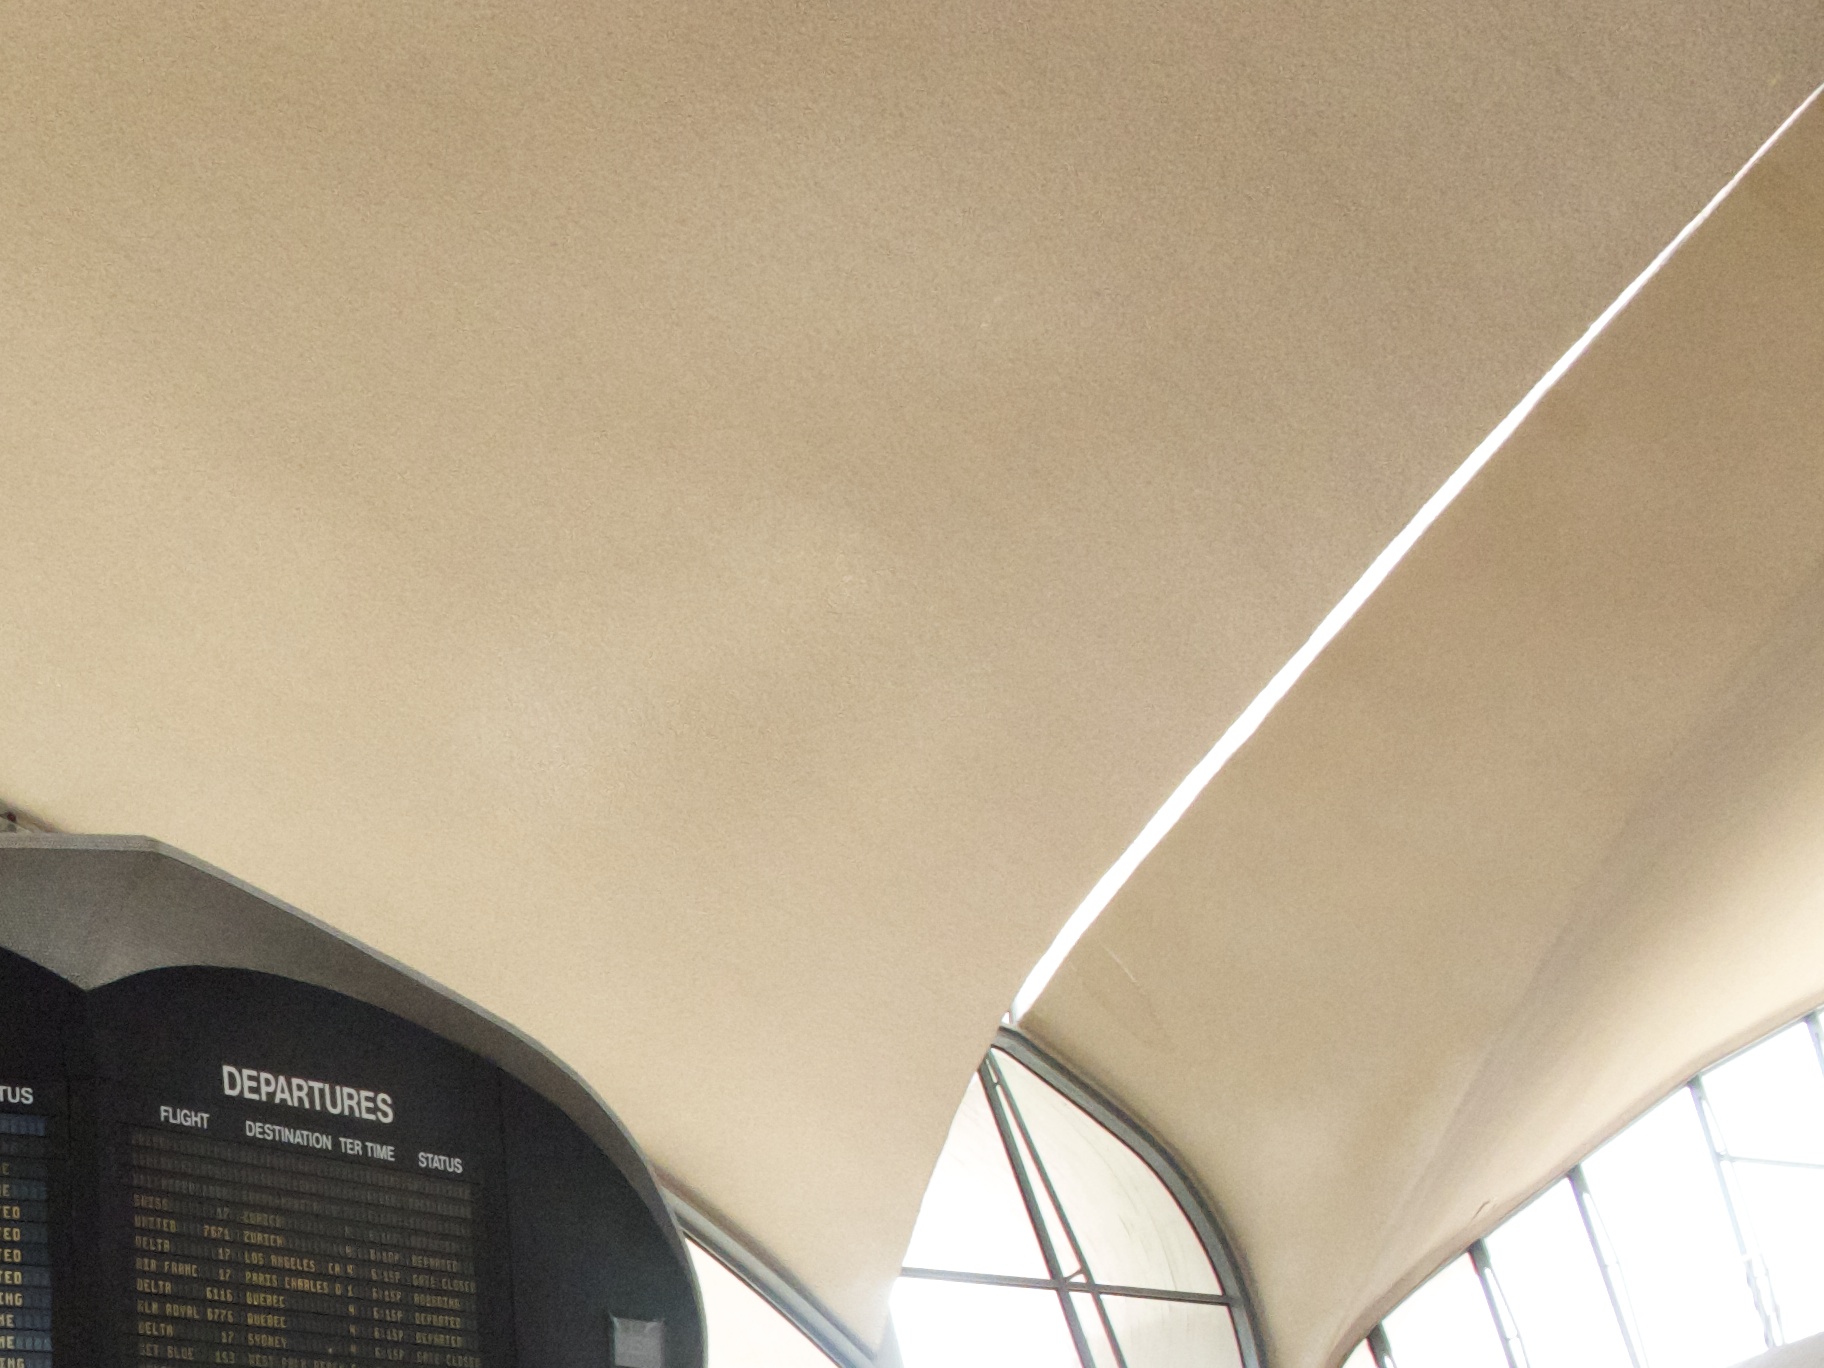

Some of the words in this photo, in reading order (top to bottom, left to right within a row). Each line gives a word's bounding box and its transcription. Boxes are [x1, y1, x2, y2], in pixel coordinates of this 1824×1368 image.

[222, 1065, 394, 1124] DEPARTURES
[160, 1105, 210, 1129] FLIGHT
[245, 1120, 332, 1151] DESTINATION
[339, 1137, 362, 1156] TER
[366, 1141, 395, 1162] TIME
[418, 1151, 463, 1174] STATUS
